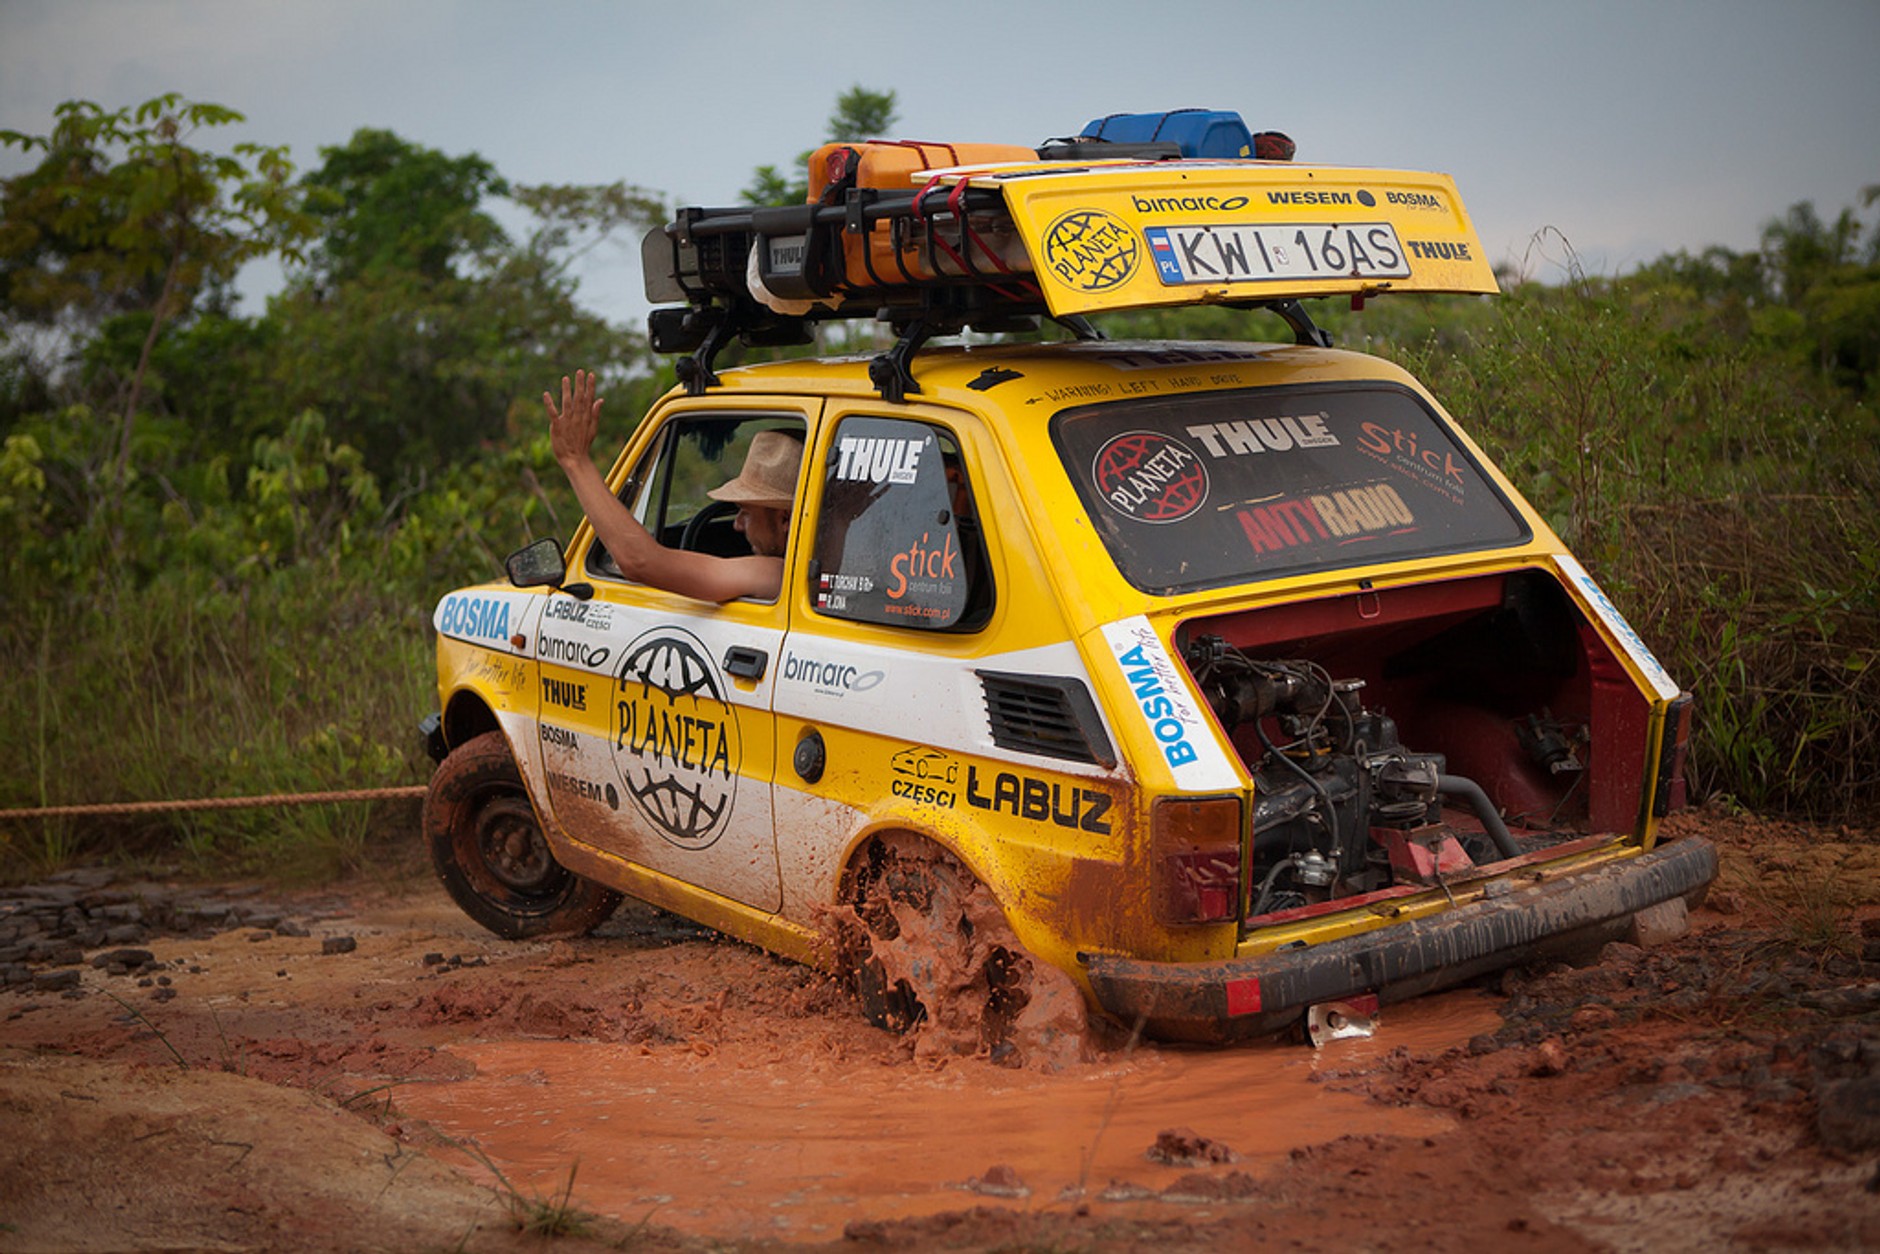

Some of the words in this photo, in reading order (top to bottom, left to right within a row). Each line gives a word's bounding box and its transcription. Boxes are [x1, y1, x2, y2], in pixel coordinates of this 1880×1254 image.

[1267, 192, 1352, 204] WESEM
[1386, 191, 1441, 207] BOSMA
[1055, 221, 1129, 283] PLANETA
[1160, 261, 1179, 273] PL
[1178, 230, 1275, 275] KWI
[1294, 228, 1399, 271] 16AS
[1407, 241, 1472, 261] THULE
[1118, 379, 1159, 395] LEFT
[1168, 375, 1201, 388] HAND
[1210, 373, 1242, 385] DRIVE
[1185, 415, 1341, 458] THULE
[1358, 422, 1464, 484] Stick
[837, 437, 924, 484] THULE
[1110, 444, 1193, 513] PLANETA
[886, 531, 957, 599] Stick
[441, 596, 510, 640] BOSMA
[538, 629, 610, 667] bimarco
[542, 677, 586, 711] THULE
[1119, 644, 1198, 768] BOSMA
[541, 724, 579, 750] BOSMA
[618, 700, 730, 781] PLANETA
[547, 771, 602, 802] WESEM
